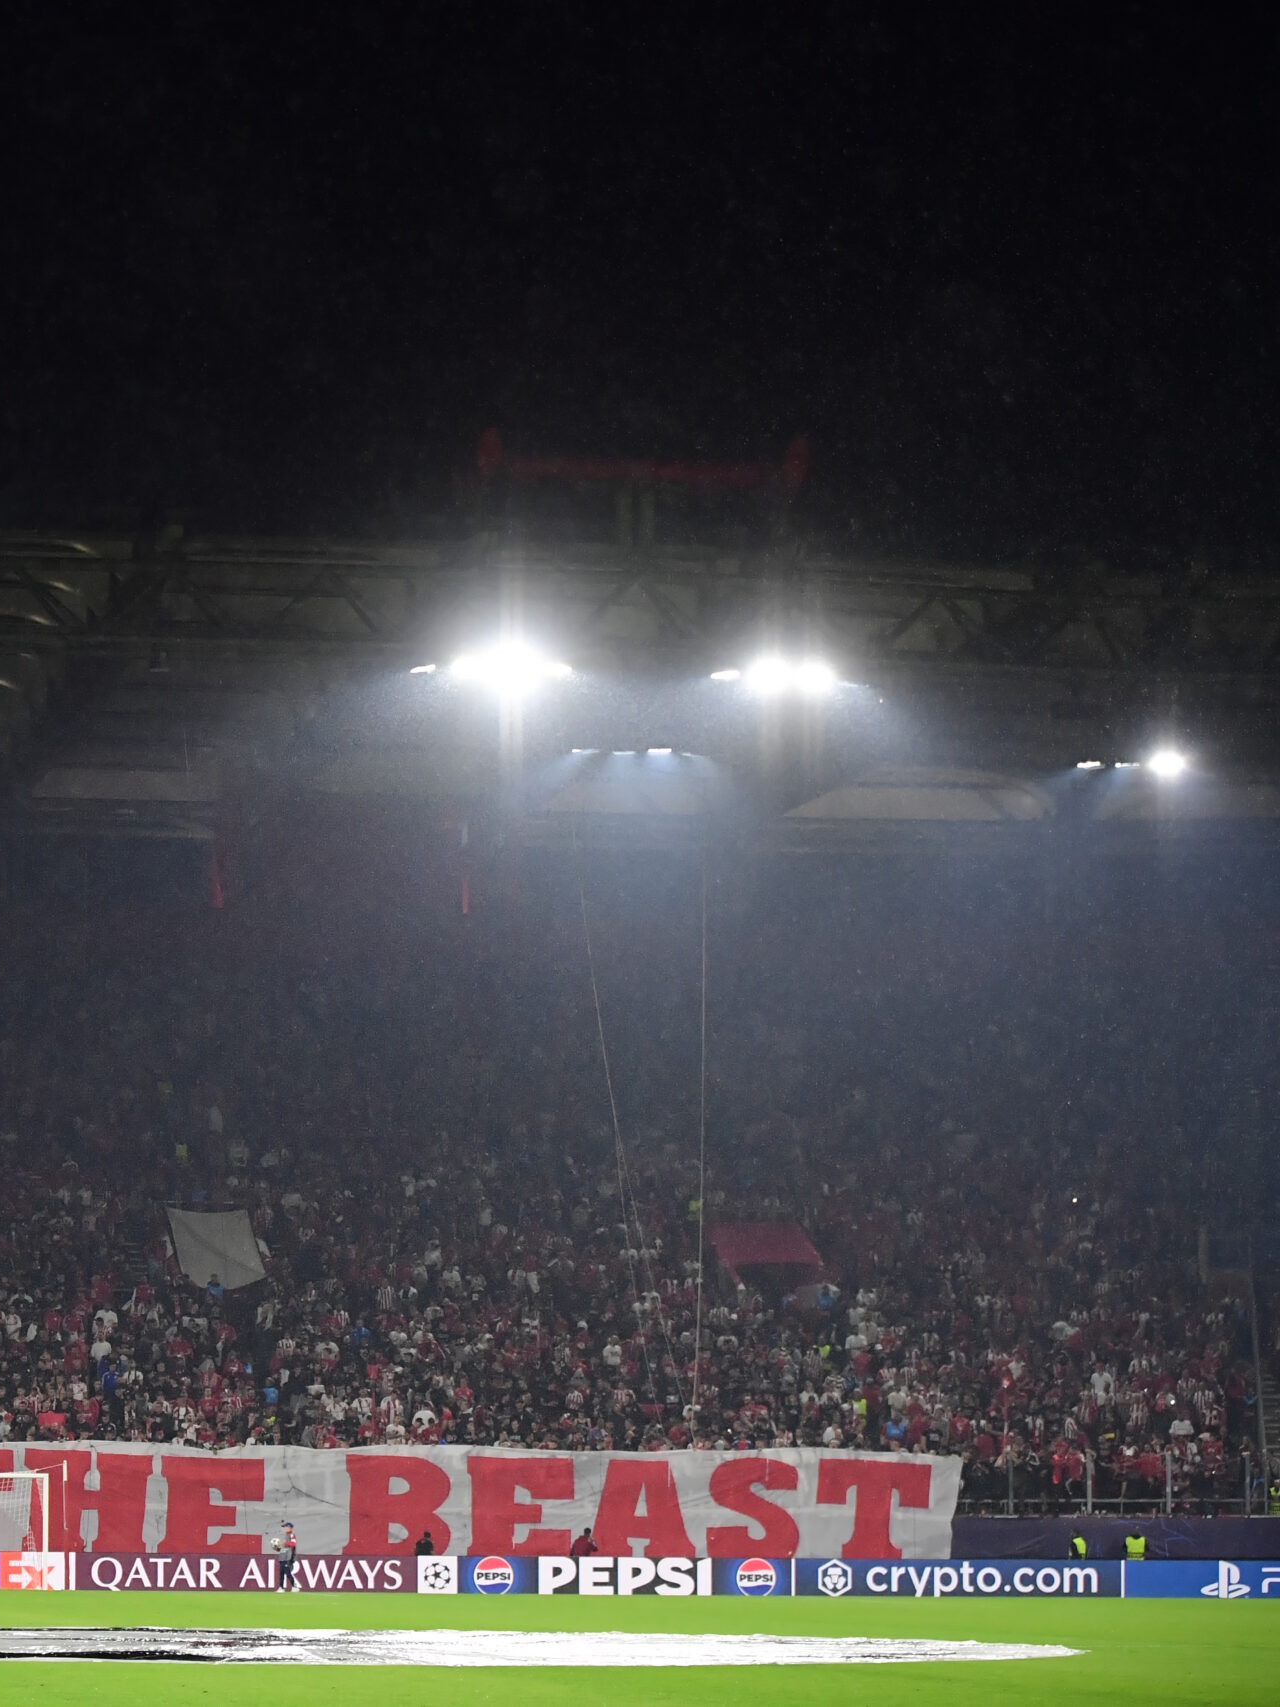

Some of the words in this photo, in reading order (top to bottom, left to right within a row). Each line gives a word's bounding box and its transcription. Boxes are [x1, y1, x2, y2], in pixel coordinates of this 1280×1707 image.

[342, 1454, 932, 1559] BEAST
[91, 1557, 223, 1591] QATAR
[239, 1558, 403, 1590] AIRWAYS
[476, 1572, 511, 1581] PEPSI
[538, 1556, 712, 1596] PEPSI
[739, 1574, 773, 1583] PEPSI
[866, 1561, 1098, 1597] crypto.com
